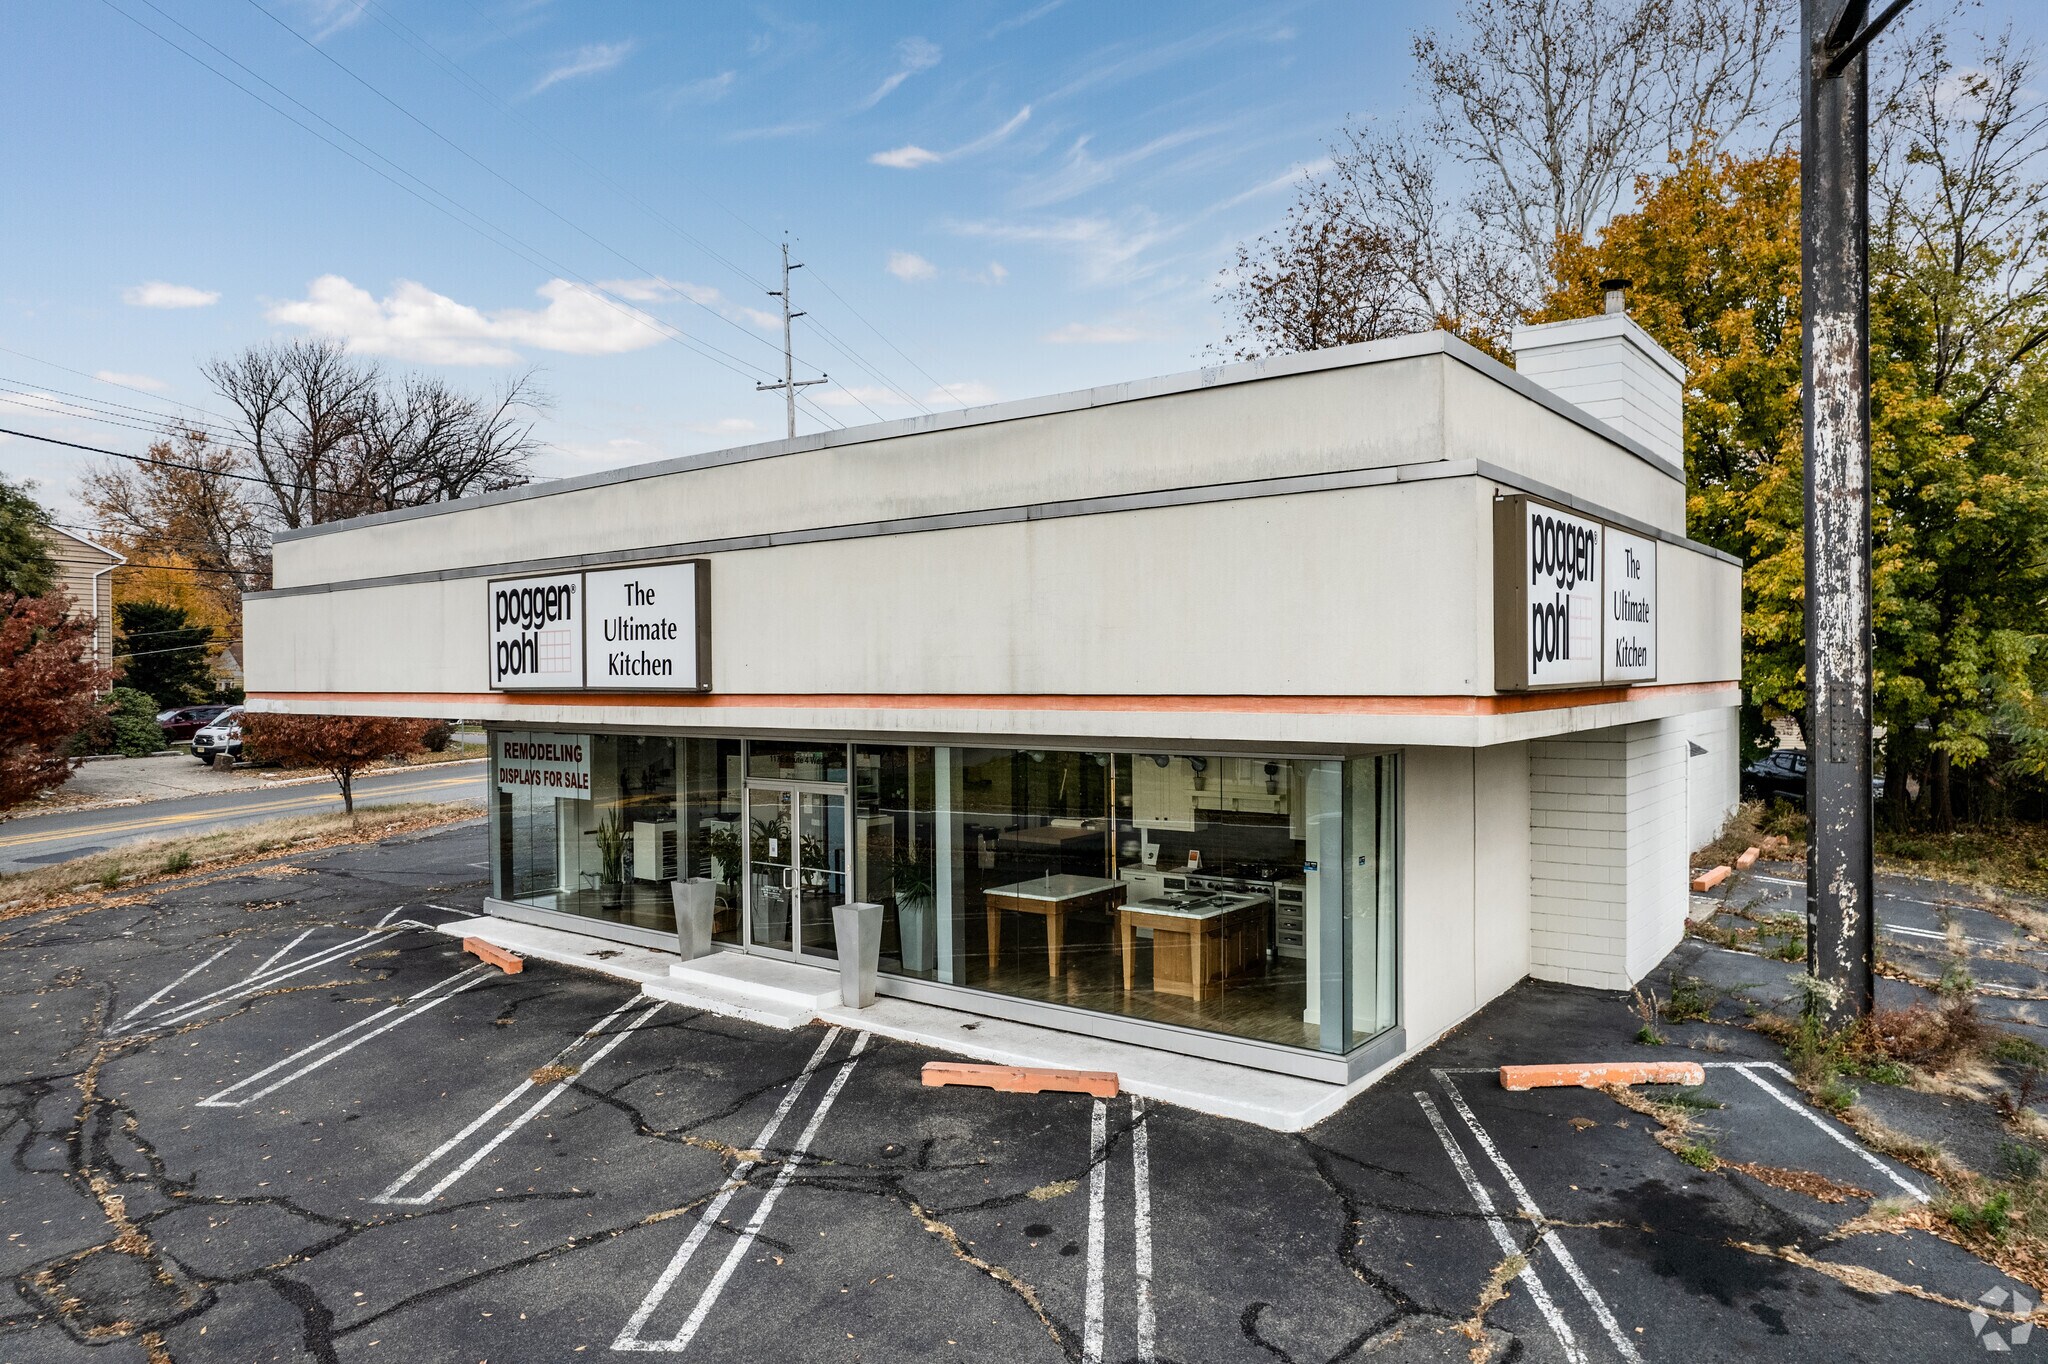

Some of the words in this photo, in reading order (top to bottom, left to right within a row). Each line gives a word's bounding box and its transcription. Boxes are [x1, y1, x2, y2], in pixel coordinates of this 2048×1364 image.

[1625, 547, 1640, 580] The
[624, 581, 655, 606] The
[1613, 589, 1650, 624] Ultimate
[604, 616, 677, 642] Ultimate
[1532, 592, 1570, 674] pohl
[497, 631, 538, 682] pohl
[608, 650, 672, 676] Kitchen
[1615, 636, 1647, 668] Kitchen
[504, 742, 583, 763] REMODELING
[500, 768, 541, 786] DISPLAYS
[543, 770, 562, 787] FOR
[564, 771, 589, 789] SALE
